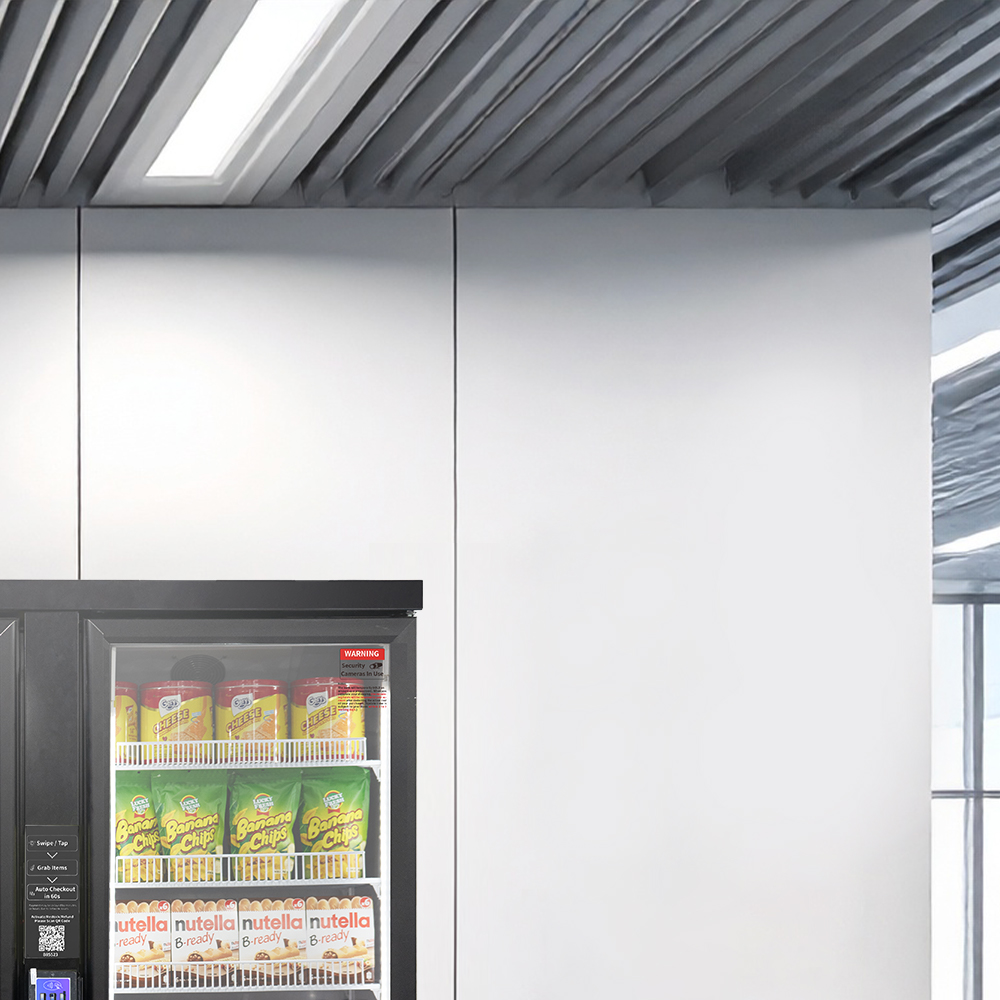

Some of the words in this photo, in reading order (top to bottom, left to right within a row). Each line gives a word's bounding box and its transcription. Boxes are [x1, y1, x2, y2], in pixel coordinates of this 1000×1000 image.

[153, 709, 189, 734] CHEESE
[226, 707, 262, 733] CHEESE
[300, 705, 337, 732] CHEESE
[166, 813, 220, 844] Banana
[236, 811, 292, 842] Banana
[307, 808, 363, 841] Banana
[322, 824, 359, 850] Chips
[180, 827, 216, 853] Chips
[250, 826, 288, 851] Chips
[175, 915, 235, 932] nutella
[243, 914, 302, 930] nutella
[310, 912, 370, 928] nutella
